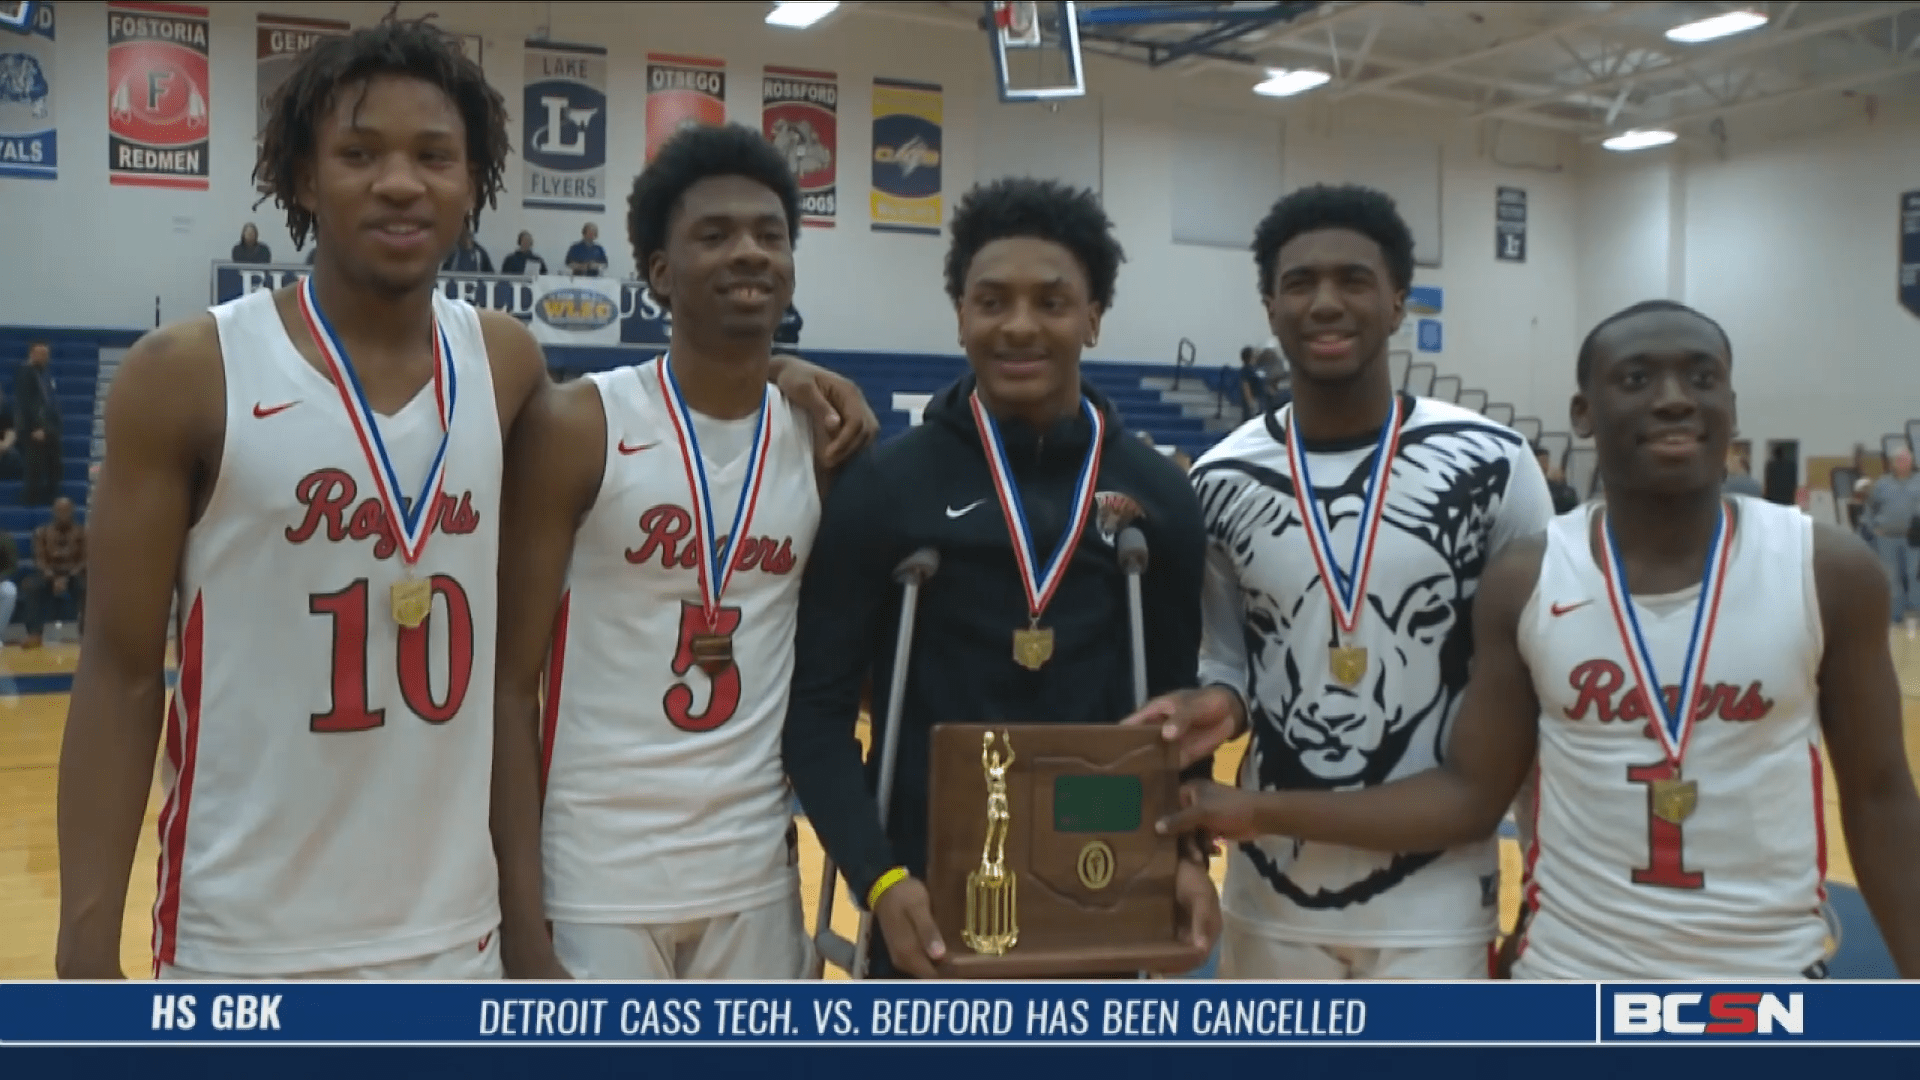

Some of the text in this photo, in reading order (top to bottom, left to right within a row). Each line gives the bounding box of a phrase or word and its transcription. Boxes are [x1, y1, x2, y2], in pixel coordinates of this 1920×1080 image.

[110, 15, 206, 45] FOSTORIA
[543, 56, 589, 79] LAKE
[652, 67, 720, 95] OTSEGO
[763, 80, 836, 105] ROSSFORD
[119, 145, 199, 173] REDMEN
[531, 173, 597, 198] FLYERS
[285, 468, 480, 560] Rogrs
[625, 504, 797, 588] Roers
[308, 575, 474, 732] 10
[663, 600, 742, 733] 5
[1627, 761, 1705, 889] 1
